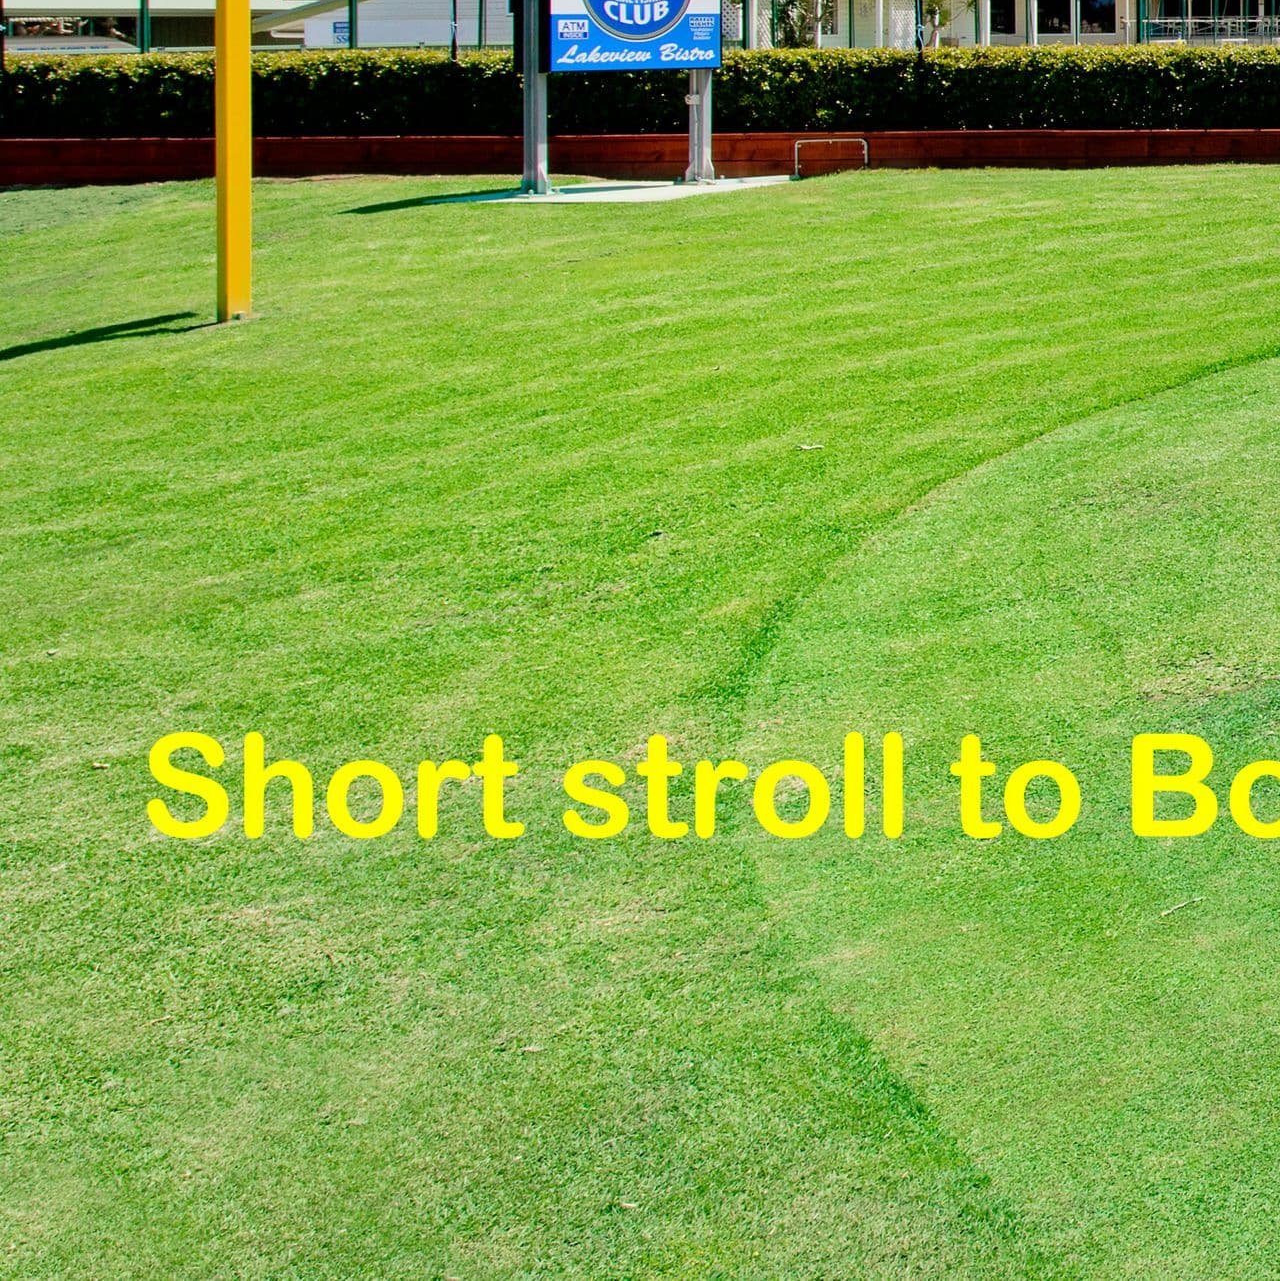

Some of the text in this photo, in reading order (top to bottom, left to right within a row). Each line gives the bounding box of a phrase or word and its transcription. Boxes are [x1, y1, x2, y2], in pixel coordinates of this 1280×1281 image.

[603, 0, 669, 25] CLUB
[562, 21, 586, 31] ATM
[556, 43, 715, 64] Lakeview Bistro
